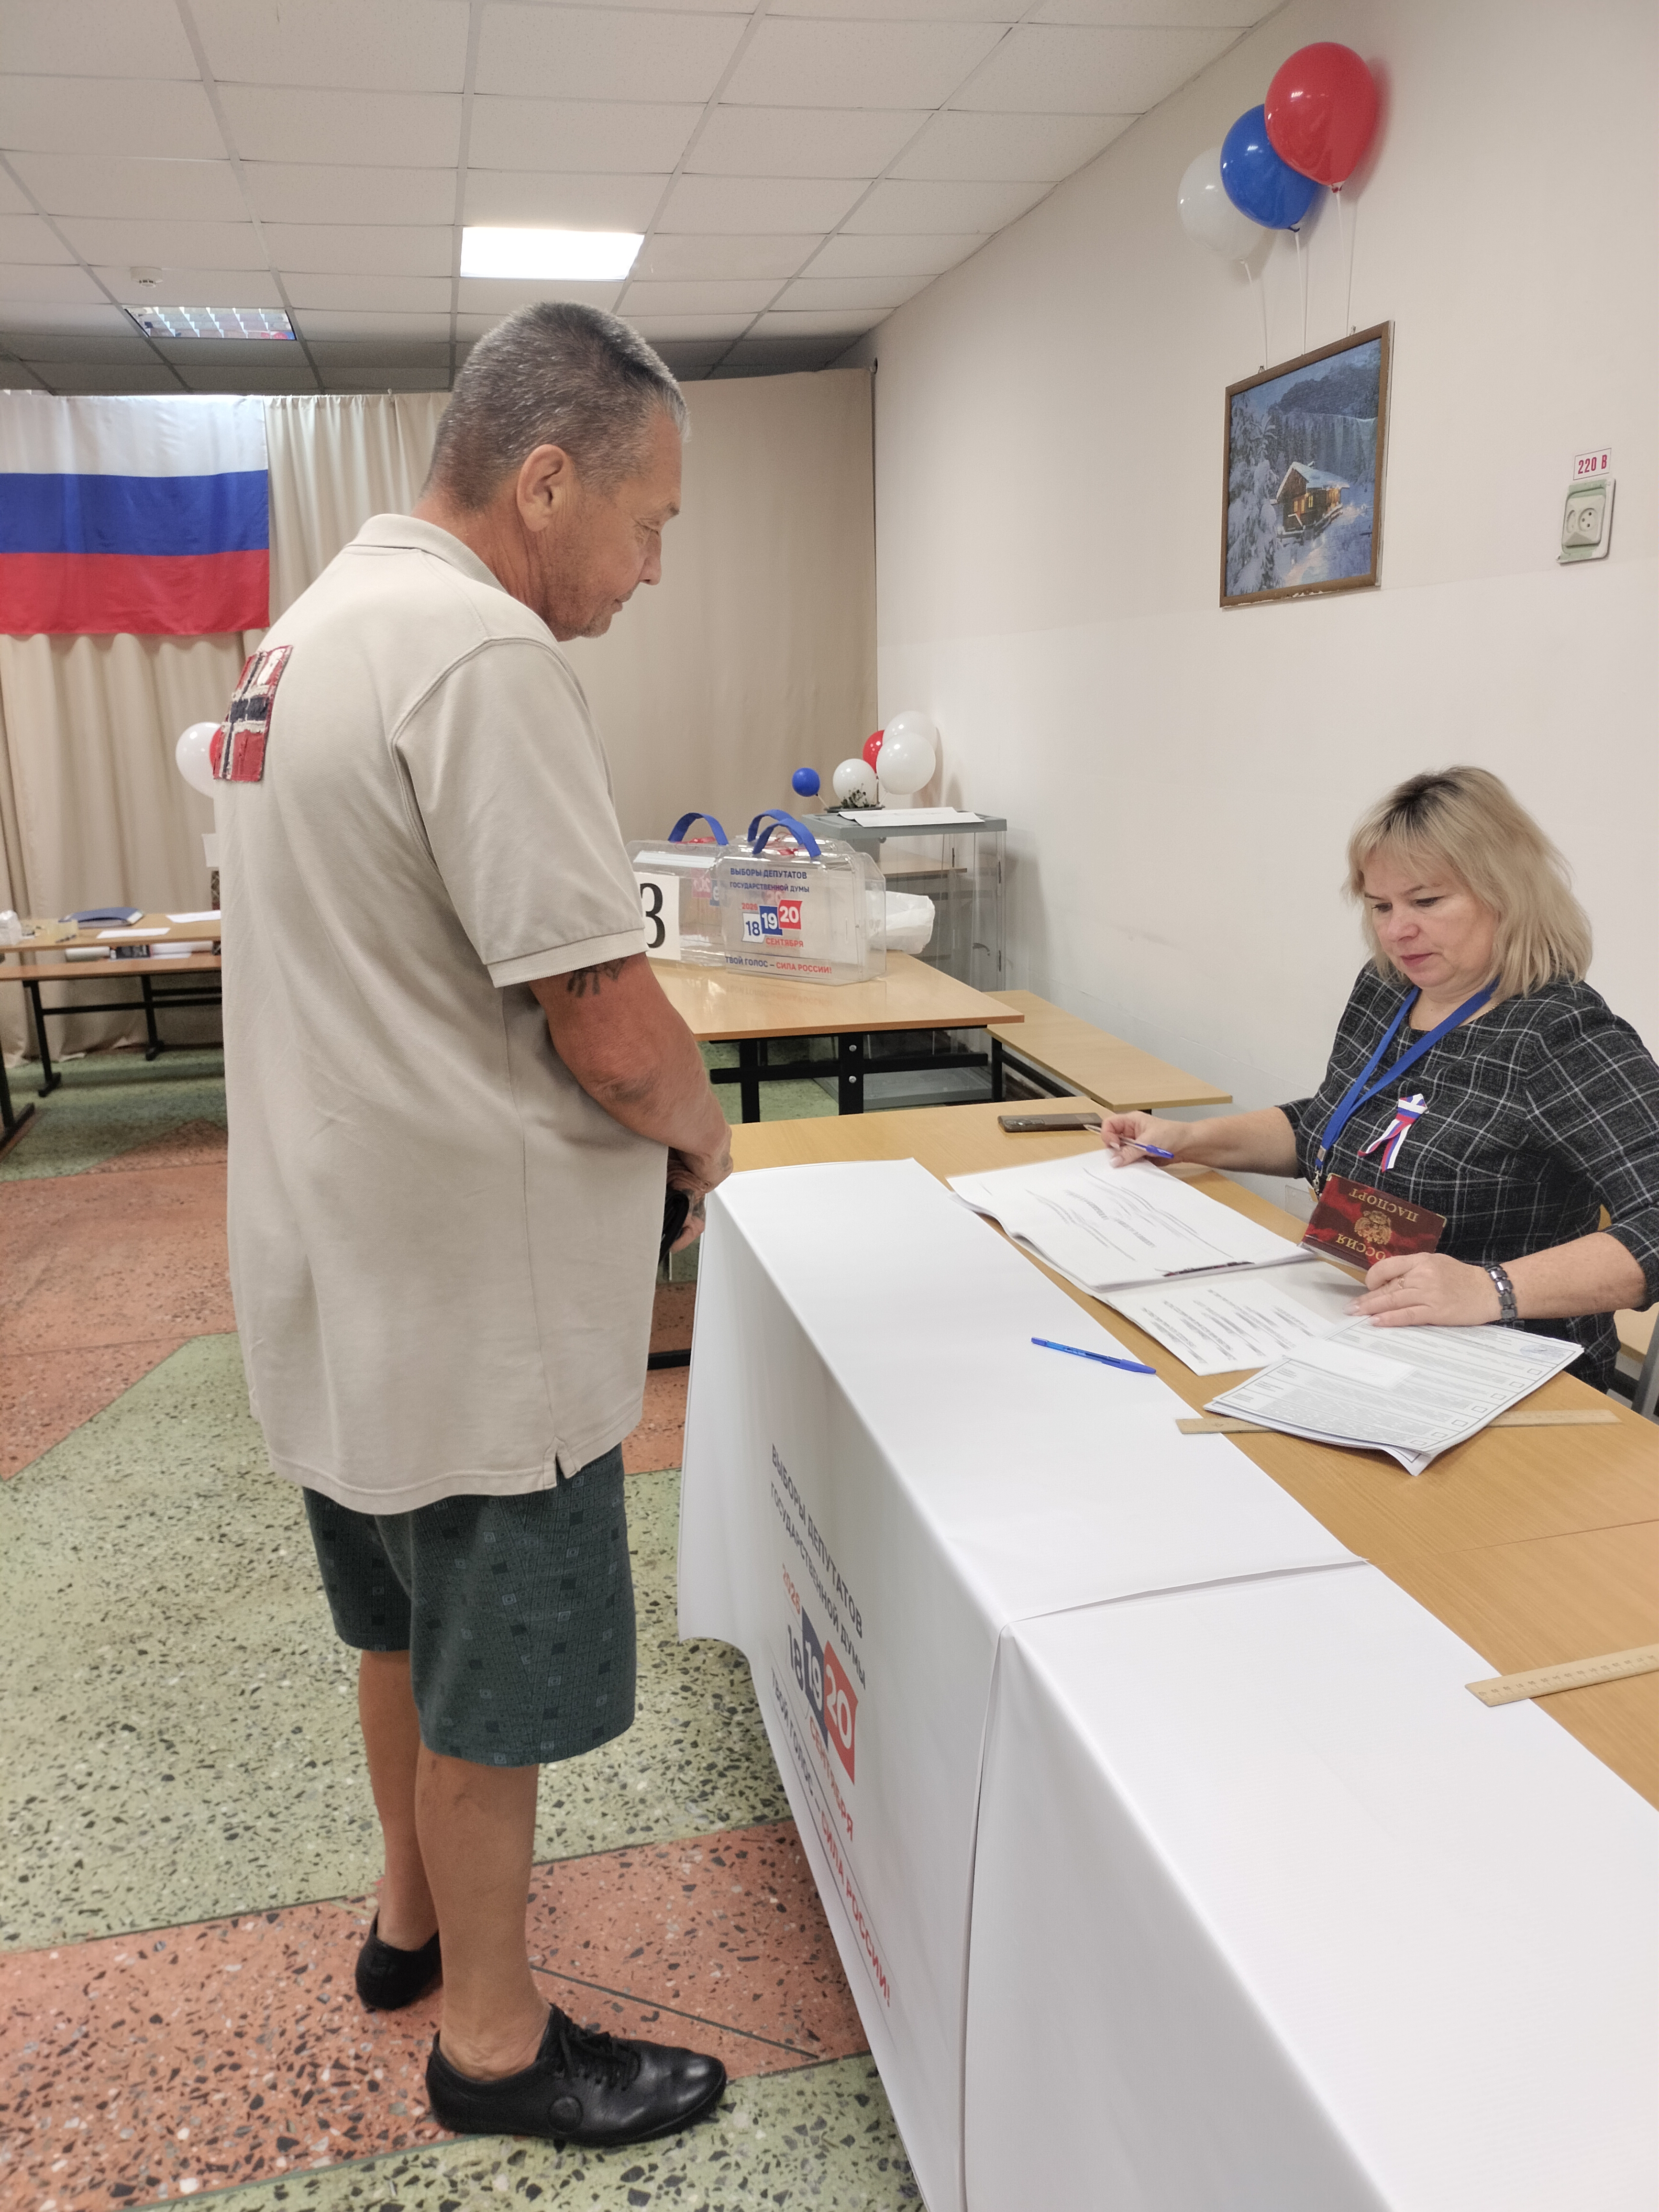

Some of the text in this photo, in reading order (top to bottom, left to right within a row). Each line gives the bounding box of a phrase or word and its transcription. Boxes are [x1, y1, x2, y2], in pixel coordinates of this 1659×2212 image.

[1578, 454, 1607, 475] 220 В
[730, 868, 807, 879] ВЫБОРЫ ДЕПУТАТОВ
[730, 882, 788, 892] ГОСУДАРСТВЕННОЙ
[745, 906, 799, 936] 18 19 20
[766, 938, 804, 947] СЕНТЯБРЯ
[725, 956, 743, 964] ТВОЙ
[745, 959, 768, 967] ГОЛОС
[776, 962, 796, 971] СИЛА
[798, 963, 832, 974] РОССИИ!
[1349, 1188, 1419, 1222] ПАСПОРТ
[1335, 1233, 1386, 1261] ОССИЯ
[773, 1442, 863, 1639] ВЫБОРЫ ДЕПУТАТОВ
[771, 1481, 866, 1691] ГОСУДАРСТВЕННОЙ ДУМЫ
[782, 1562, 801, 1615] 2026
[788, 1624, 852, 1749] 18 19 20
[809, 1715, 853, 1842] СЕНТЯБРЯ
[821, 1810, 844, 1885] СИЛА
[846, 1876, 890, 2008] РОССИИ!
